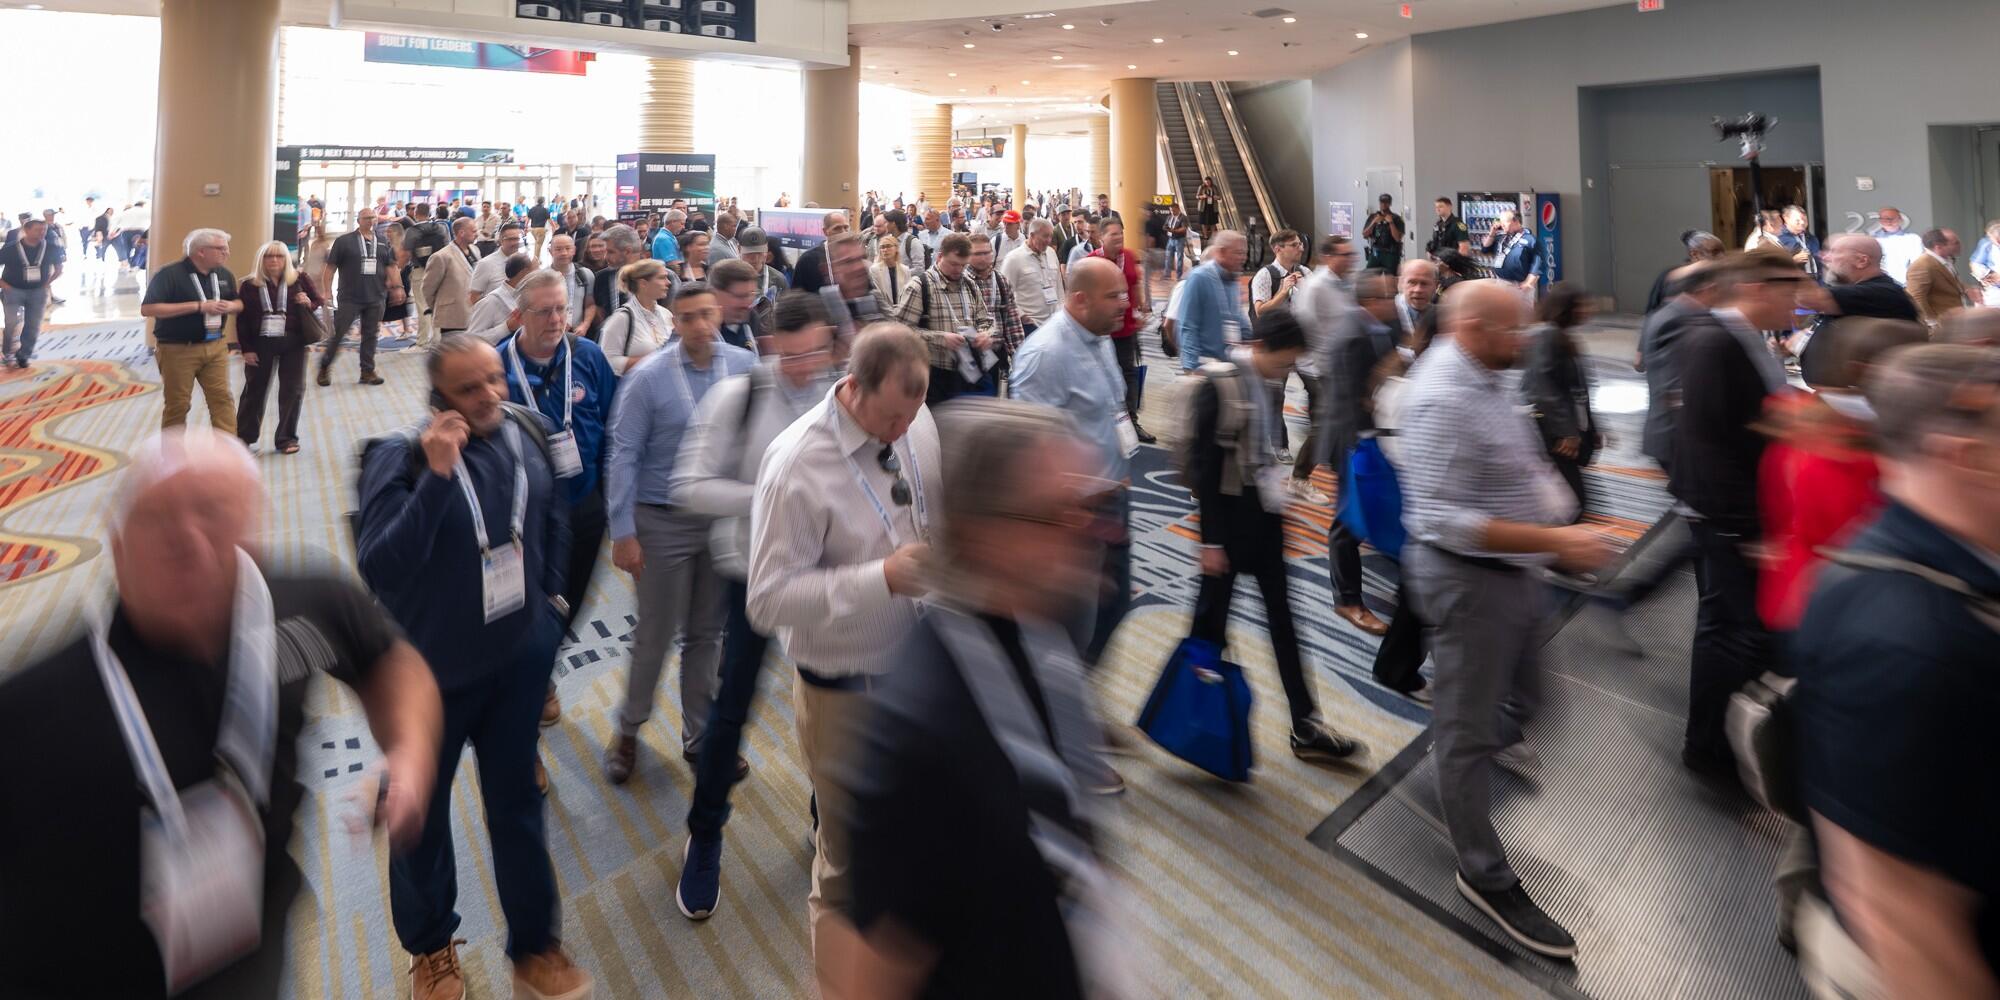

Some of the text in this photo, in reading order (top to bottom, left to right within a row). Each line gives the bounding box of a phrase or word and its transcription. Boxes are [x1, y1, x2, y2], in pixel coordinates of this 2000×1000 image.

[379, 35, 475, 53] BUILT FOR LEADERS.
[309, 148, 323, 158] YOU
[324, 148, 343, 158] NEXT
[343, 149, 361, 158] YEAR
[362, 149, 370, 158] IN
[370, 149, 384, 158] LAS
[408, 150, 446, 159] SEPTEMBER
[646, 164, 664, 172] THANK
[665, 164, 676, 172] YOU
[677, 164, 688, 172] FOR
[688, 164, 709, 172] COMING
[640, 198, 652, 206] SEE
[652, 198, 662, 206] YOU
